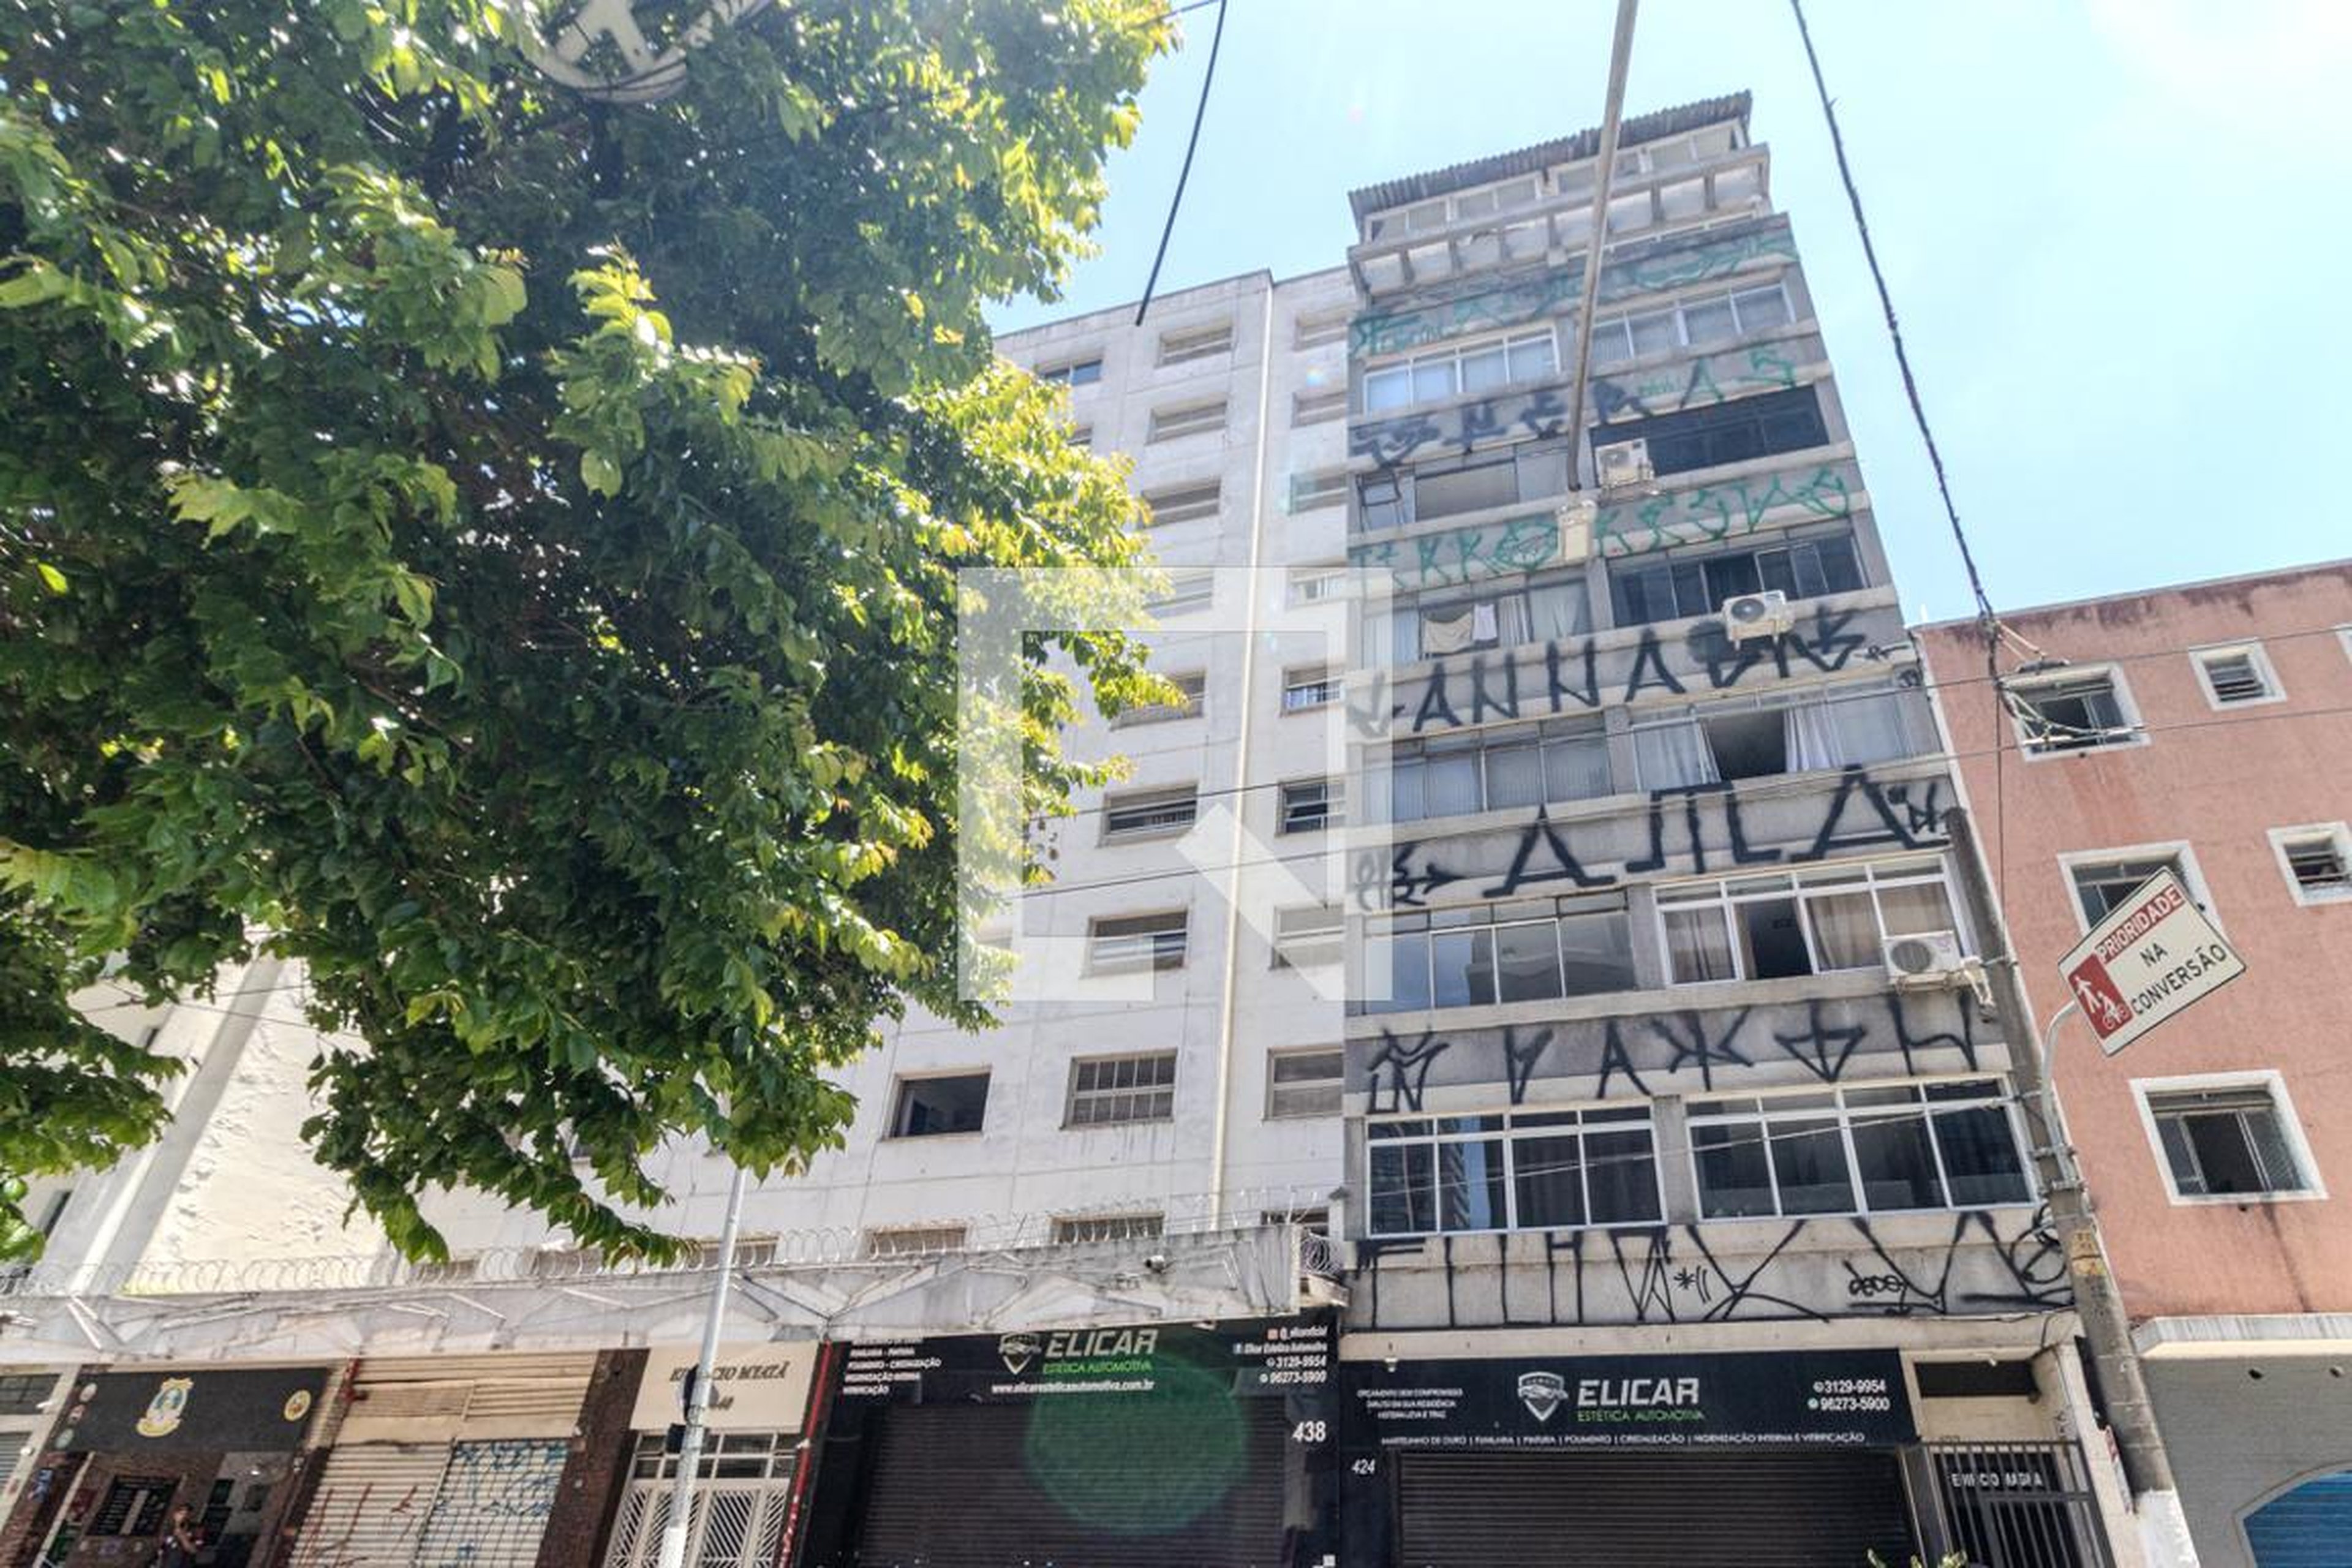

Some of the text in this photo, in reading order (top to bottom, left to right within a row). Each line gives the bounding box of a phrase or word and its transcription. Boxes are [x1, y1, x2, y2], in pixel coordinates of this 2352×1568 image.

[2096, 885, 2185, 963] PRIORIDADE
[2139, 942, 2169, 968] NA
[2130, 943, 2228, 1016] CONVERSÃO
[1045, 1329, 1158, 1357] ELICAR
[1088, 1360, 1153, 1373] AUTOMOTIVA
[1577, 1378, 1700, 1406] ELICAR
[1825, 1379, 1887, 1393] 3129-9954
[1634, 1409, 1704, 1421] AUTOMOTIVA
[1292, 1420, 1326, 1442] 438
[1352, 1459, 1375, 1475] 424
